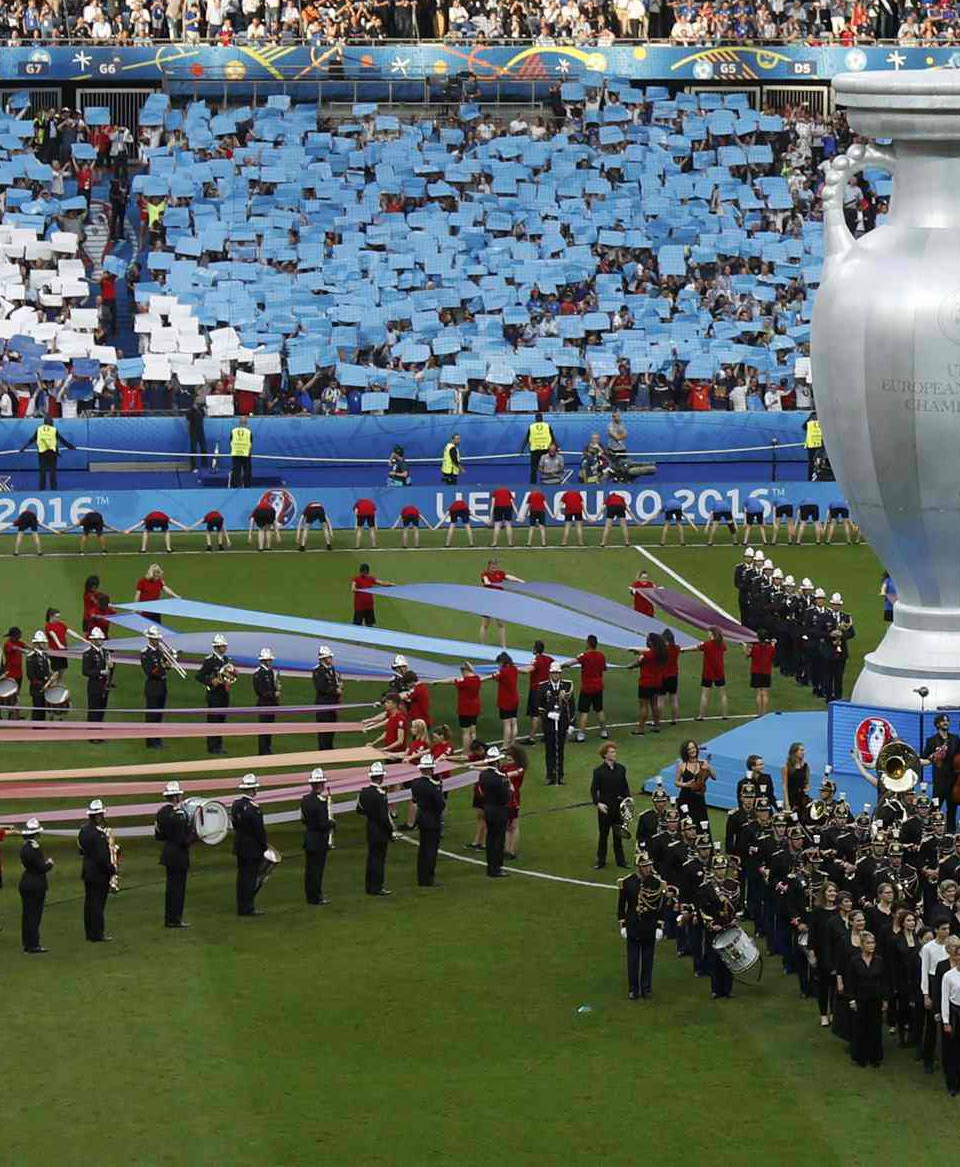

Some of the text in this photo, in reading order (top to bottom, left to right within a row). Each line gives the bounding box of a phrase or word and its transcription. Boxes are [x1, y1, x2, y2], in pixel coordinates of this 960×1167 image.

[25, 63, 42, 74] G7
[99, 63, 116, 74] G6
[720, 63, 736, 74] G5
[794, 63, 811, 74] D5
